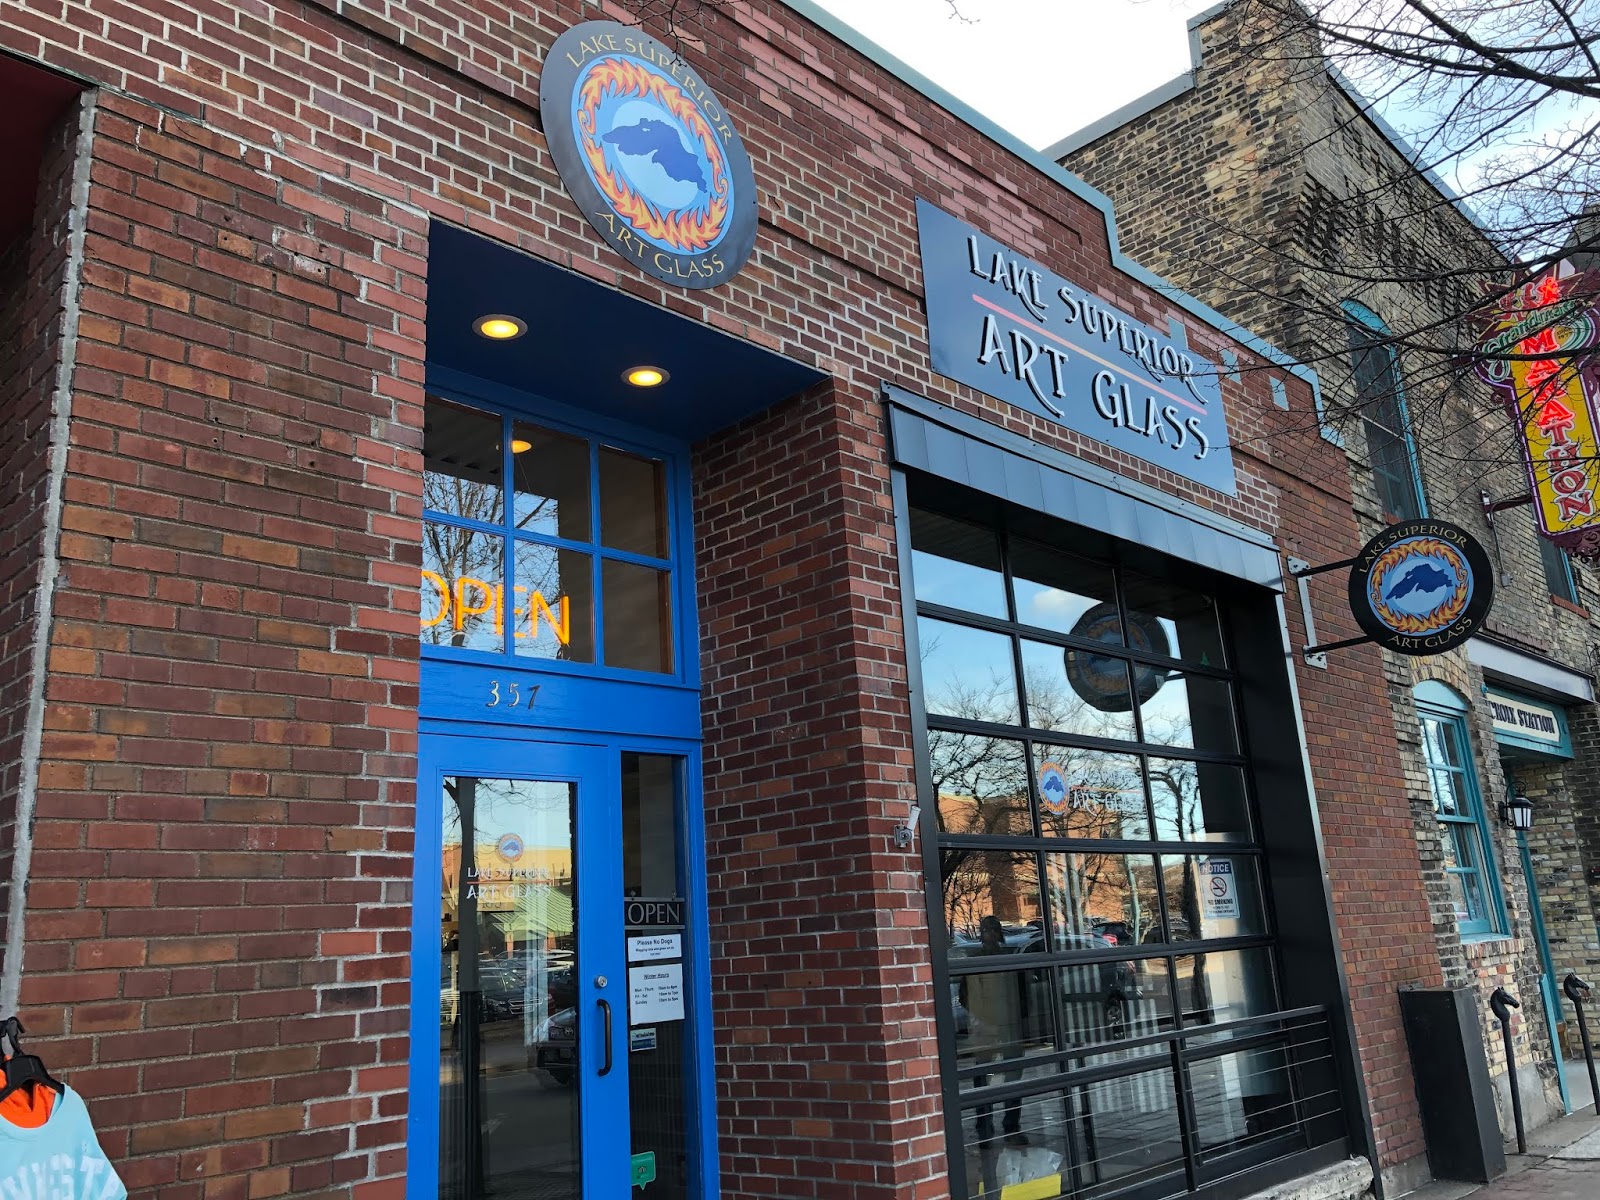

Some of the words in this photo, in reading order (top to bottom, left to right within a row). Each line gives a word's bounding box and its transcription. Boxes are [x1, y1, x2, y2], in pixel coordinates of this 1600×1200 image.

[566, 34, 621, 68] LAKE
[624, 37, 732, 145] SUPERIOR
[595, 210, 649, 258] ART
[654, 253, 725, 279] GLASS
[967, 235, 1049, 321] LAKE
[1058, 286, 1209, 404] SUPERIOR
[977, 314, 1070, 418] ART
[1091, 370, 1210, 460] GLASS
[1518, 328, 1594, 522] MARATHON
[1359, 539, 1388, 573] LAKE
[1389, 525, 1467, 549] SUPERIOR
[420, 570, 570, 646] OPEN
[1387, 636, 1422, 649] ART
[1424, 617, 1473, 648] GLASS
[486, 680, 541, 710] 357
[1517, 709, 1556, 734] STATION
[1202, 863, 1229, 874] NOTICE
[466, 884, 498, 902] ART
[627, 902, 680, 924] OPEN
